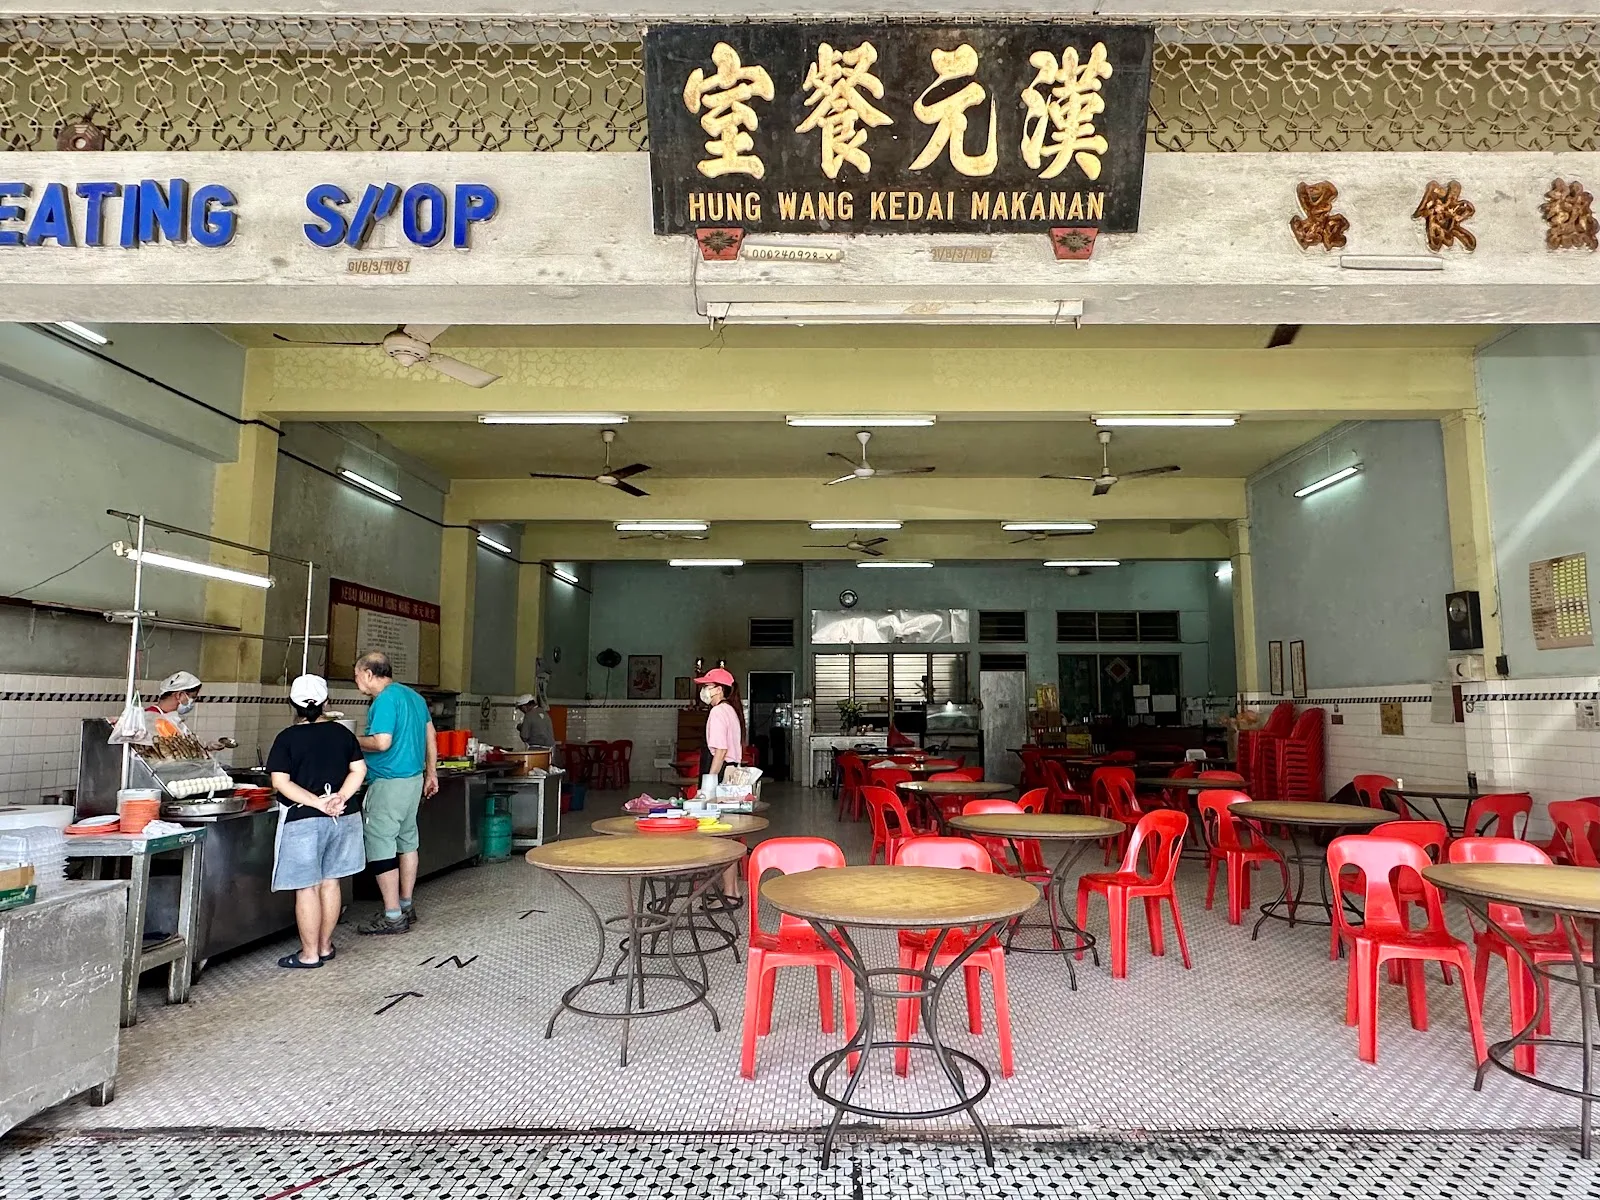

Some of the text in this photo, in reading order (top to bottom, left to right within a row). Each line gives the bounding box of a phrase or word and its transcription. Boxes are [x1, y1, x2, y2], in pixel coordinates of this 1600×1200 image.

[0, 178, 238, 249] EATING
[688, 191, 1105, 221] HUNG WANG KEDAI MAKANAN
